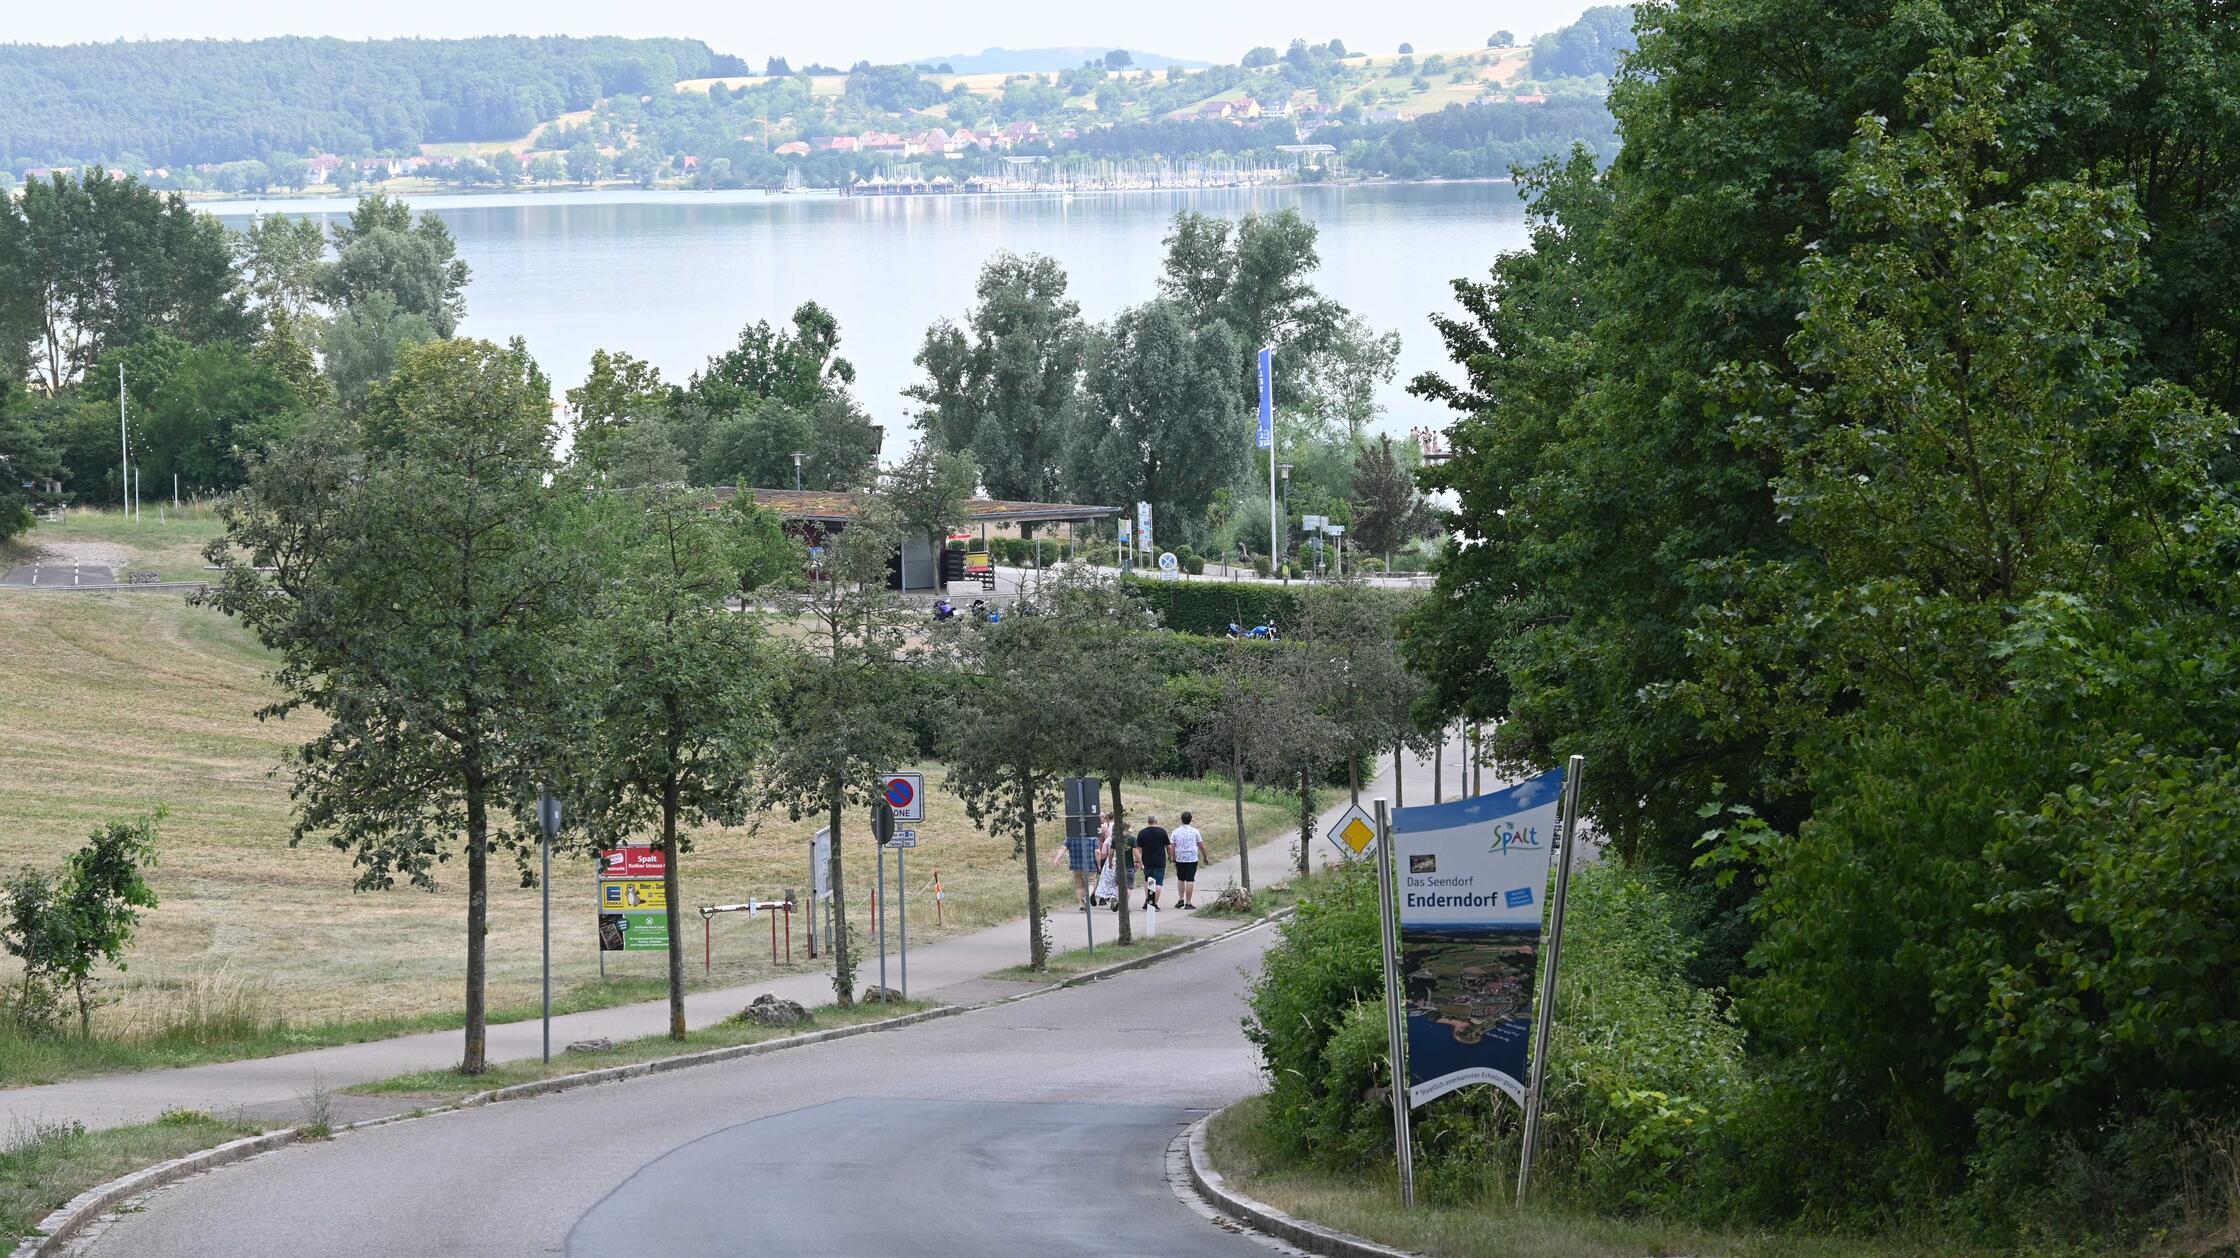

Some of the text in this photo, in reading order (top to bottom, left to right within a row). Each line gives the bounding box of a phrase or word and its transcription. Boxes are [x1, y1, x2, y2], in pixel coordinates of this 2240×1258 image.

[893, 809, 911, 817] ONE
[637, 855, 657, 863] Spalt
[1407, 876, 1474, 887] Das Seendorf
[1407, 891, 1498, 908] Enderndorf
[1419, 1082, 1445, 1096] Staatlich
